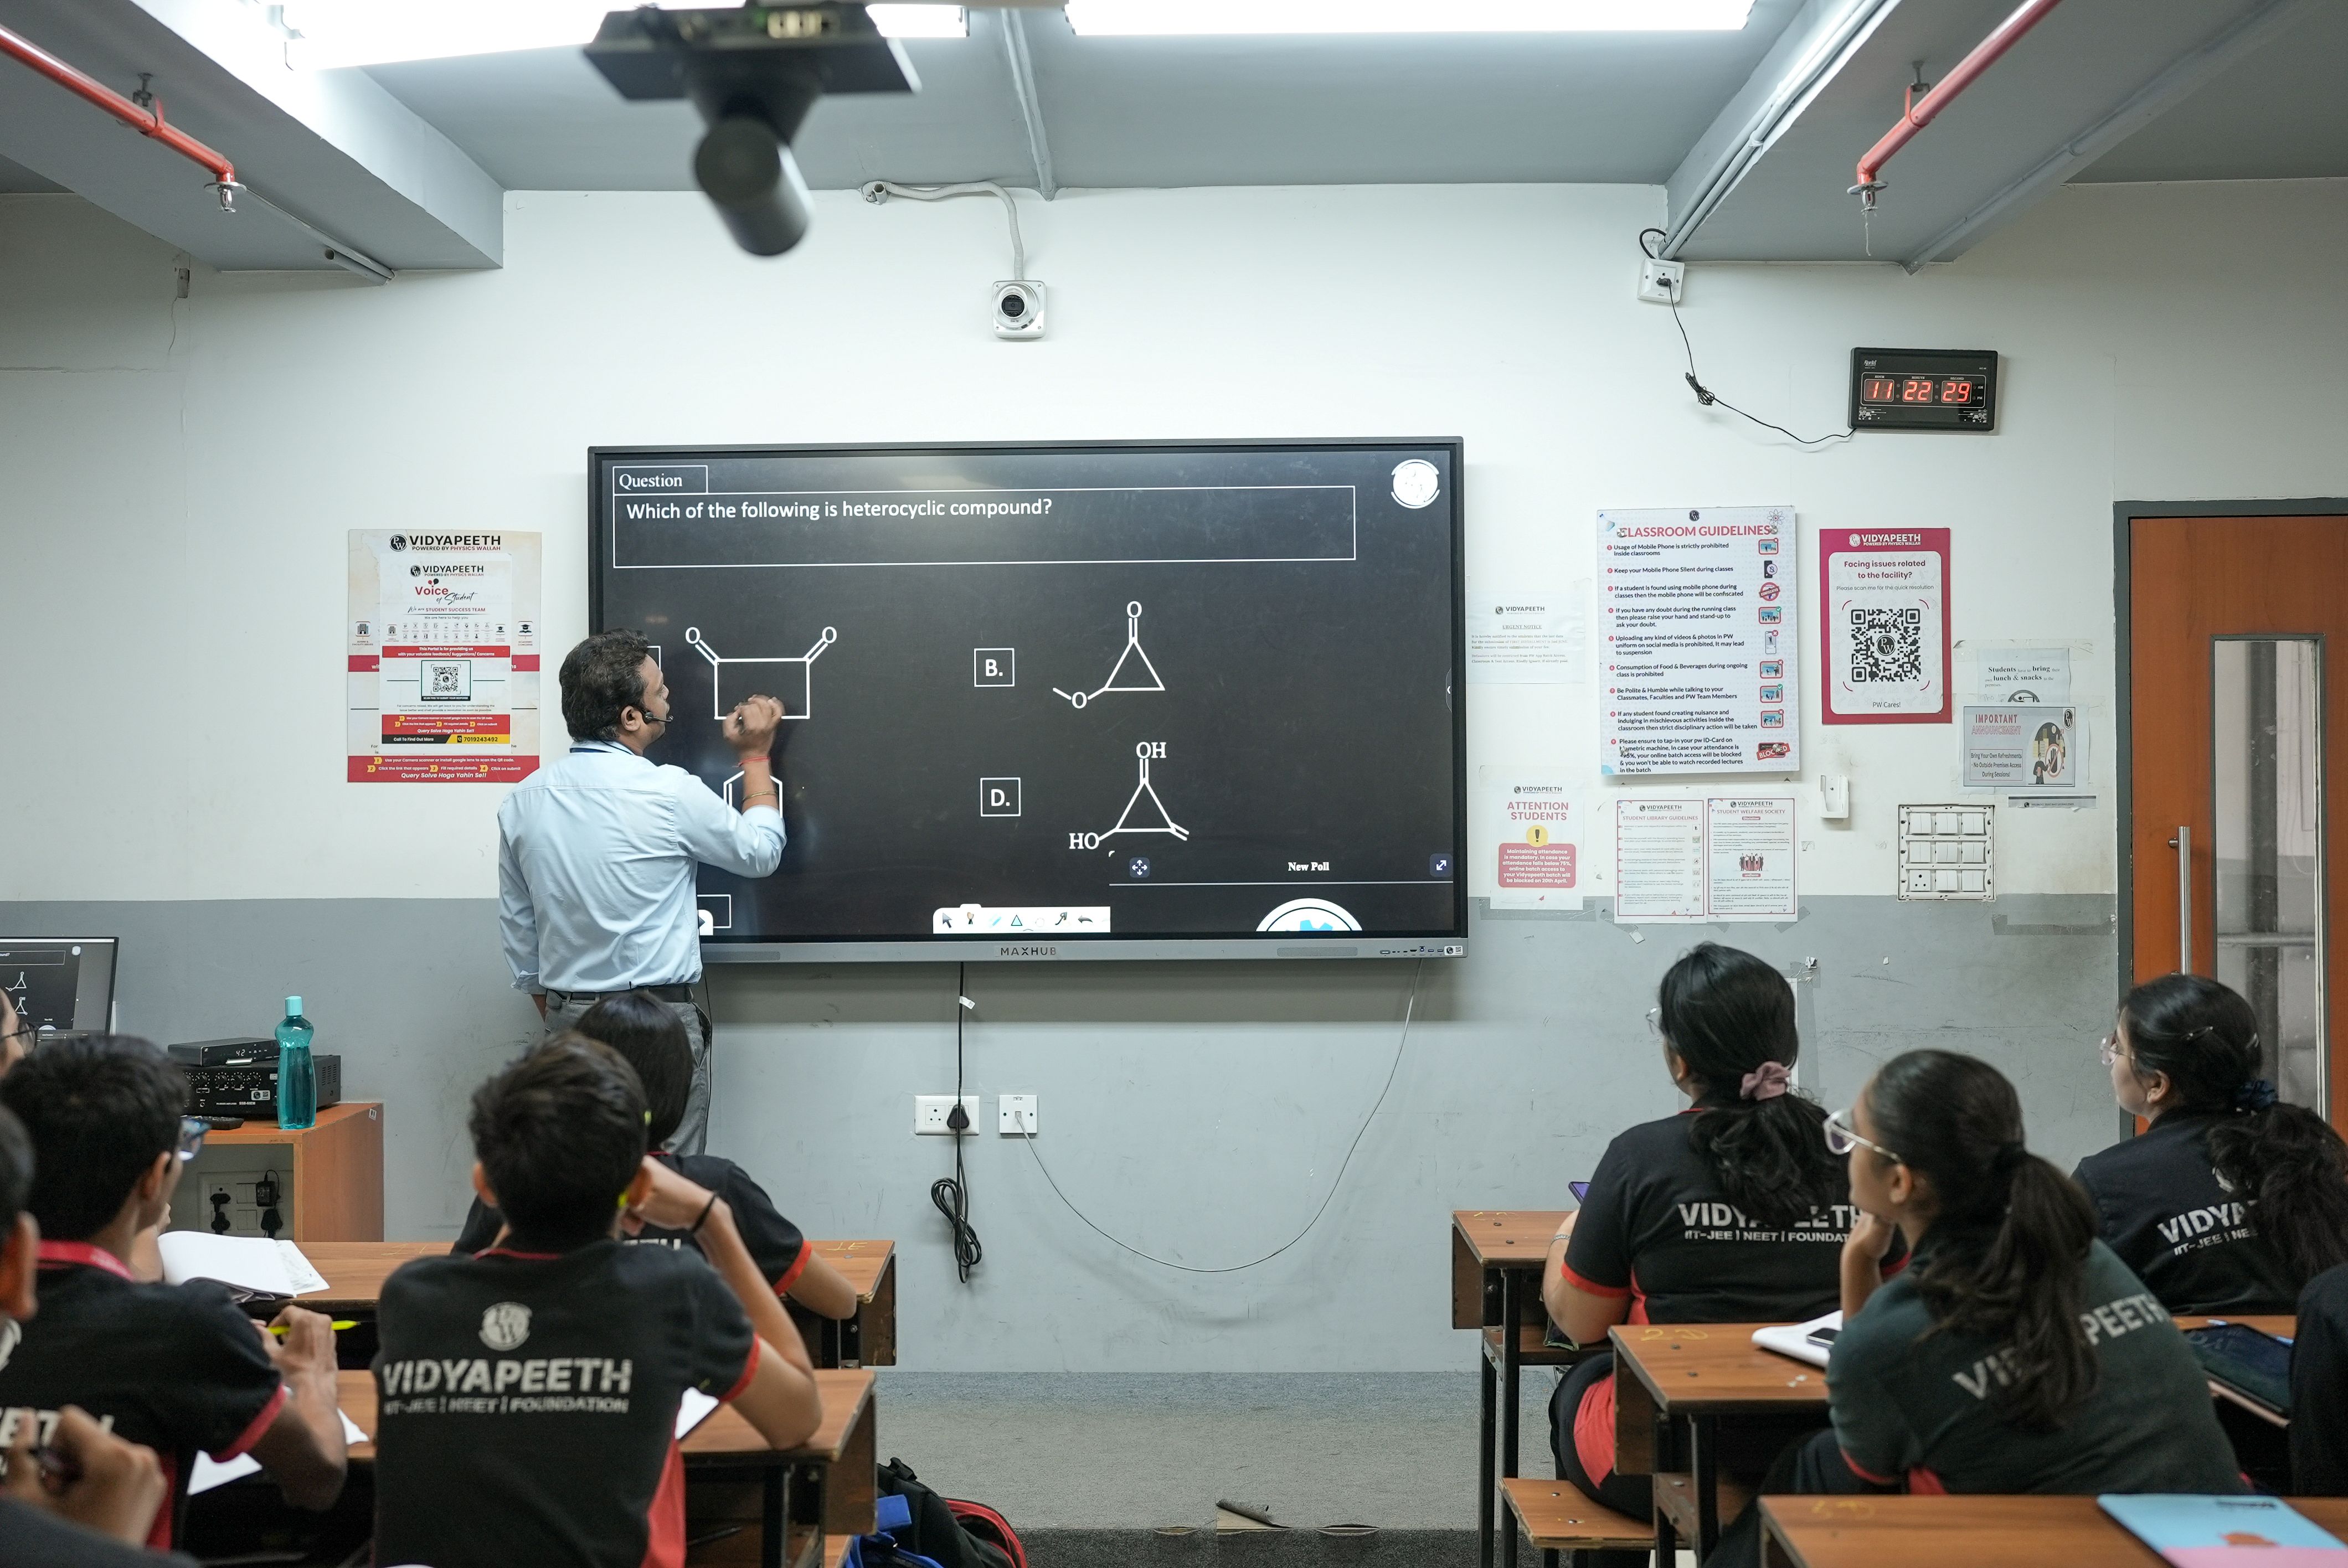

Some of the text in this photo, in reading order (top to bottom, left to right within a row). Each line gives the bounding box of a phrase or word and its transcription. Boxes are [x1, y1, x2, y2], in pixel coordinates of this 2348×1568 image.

[1873, 381, 1970, 401] 11 22 29
[619, 473, 682, 490] Question
[626, 498, 1052, 520] Which of the following is heterocyclic compound?
[1699, 524, 1770, 535] GUIDELINES
[409, 535, 500, 545] VIDYAPEETH
[1861, 534, 1921, 542] VIDYAPEETH
[1844, 560, 1870, 569] Facing
[1882, 571, 1912, 580] facility?
[415, 585, 449, 595] Voice
[444, 592, 477, 605] Student
[985, 659, 1003, 677] B.
[1976, 714, 2018, 723] IMPORTANT
[1971, 725, 2021, 734] ANNOUNCEMENT
[1136, 741, 1167, 759] OH
[991, 788, 1010, 806] D.
[1511, 812, 1566, 820] STUDENTS
[1069, 832, 1100, 849] HO
[1288, 862, 1329, 870] New Poll
[1001, 947, 1055, 955] MAXHUB
[1743, 1231, 1778, 1241] NEET
[1788, 1232, 1848, 1243] FOUNDAT
[383, 1358, 633, 1396] VIDYAPEETH
[448, 1397, 498, 1414] NEET
[509, 1396, 629, 1414] FOUNDATION
